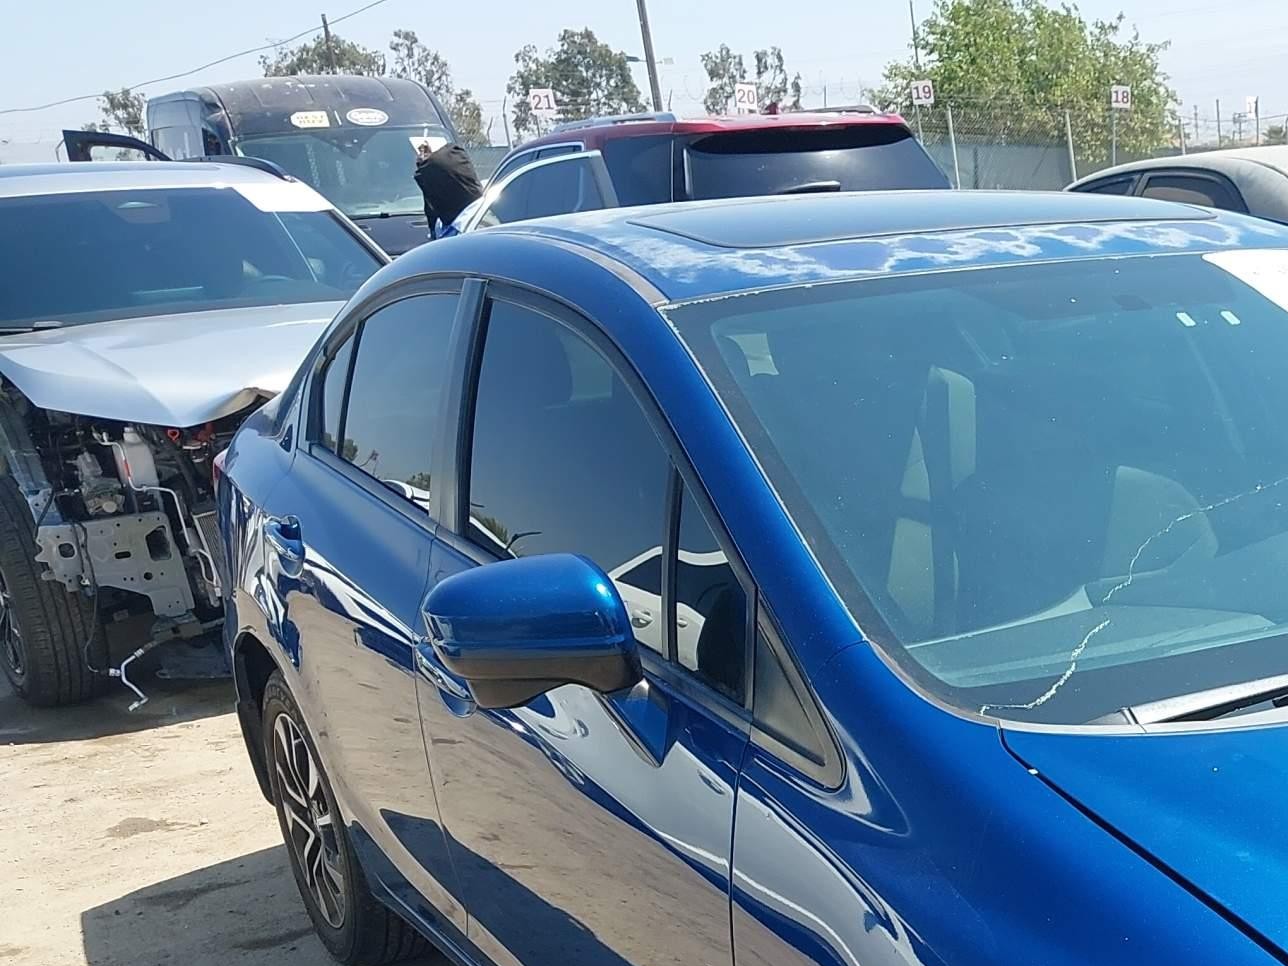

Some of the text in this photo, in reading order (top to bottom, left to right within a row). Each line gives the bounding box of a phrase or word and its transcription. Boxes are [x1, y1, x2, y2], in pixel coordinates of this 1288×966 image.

[737, 88, 755, 104] 20
[913, 85, 931, 100] 19
[1113, 90, 1129, 104] 18
[532, 94, 554, 110] 21
